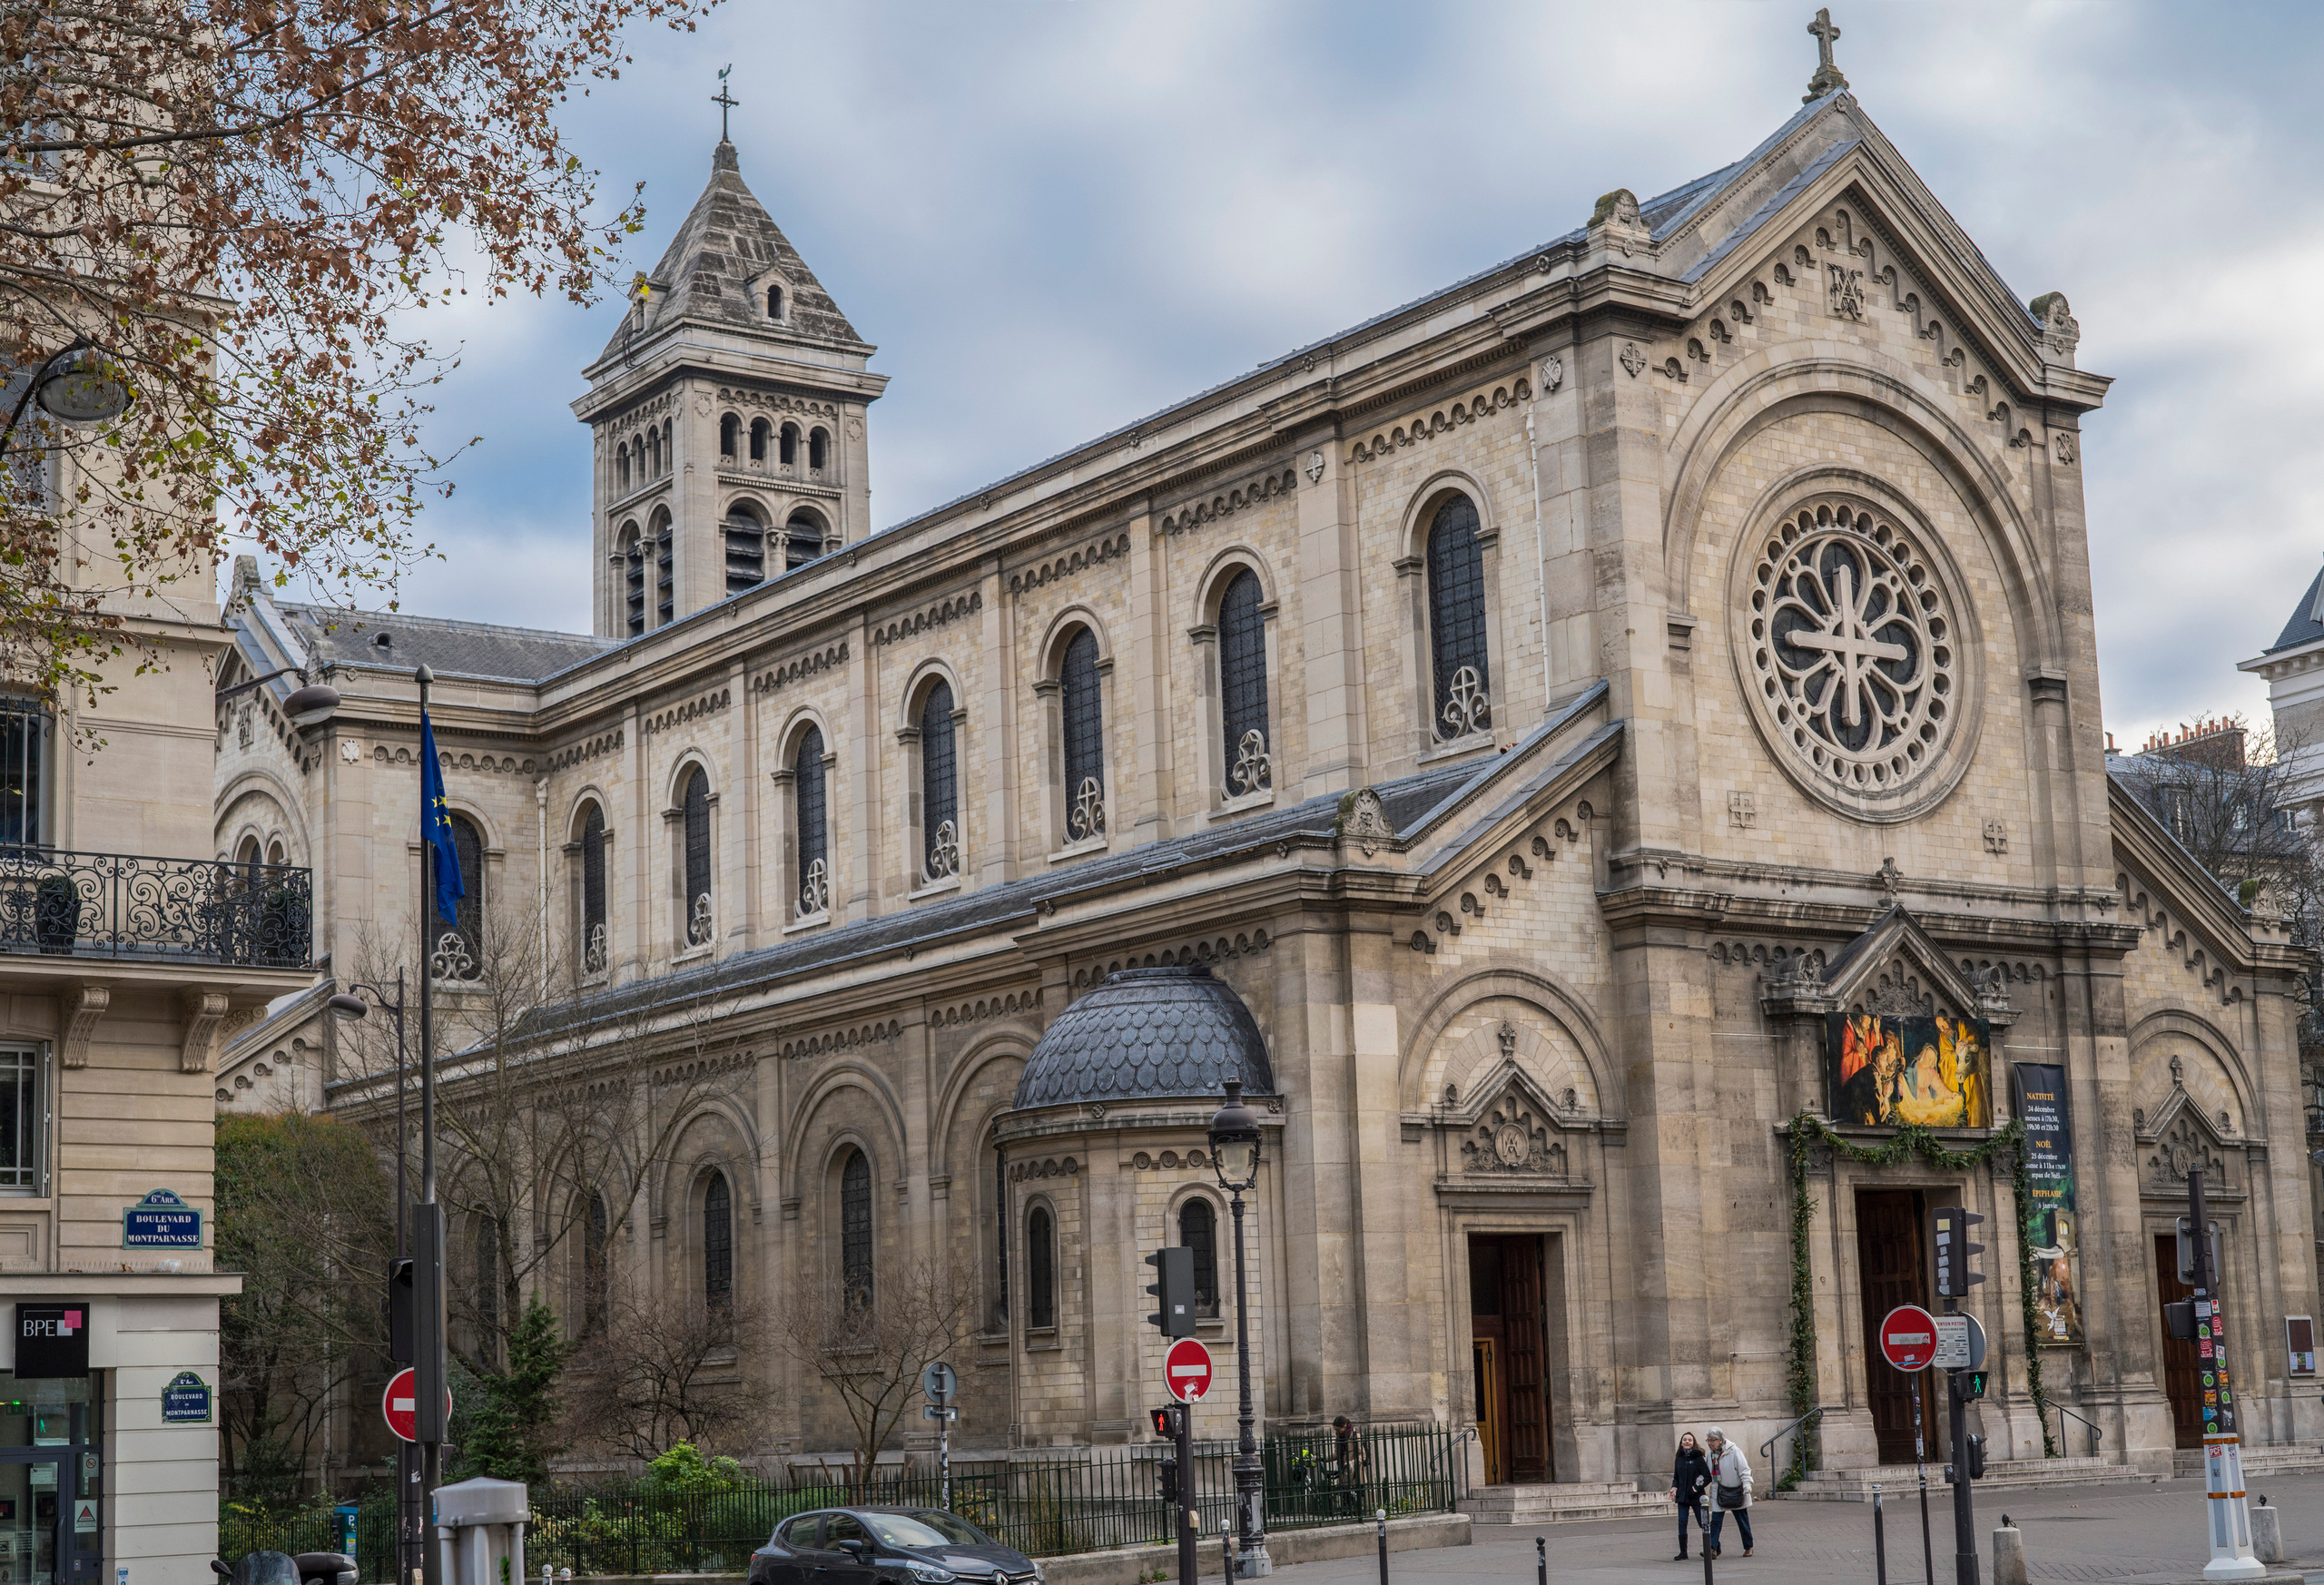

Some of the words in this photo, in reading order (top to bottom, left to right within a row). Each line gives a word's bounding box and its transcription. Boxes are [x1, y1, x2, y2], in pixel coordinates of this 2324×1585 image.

[2026, 1092, 2055, 1101] NATIVITÉ
[2034, 1105, 2055, 1113] décembre
[2035, 1139, 2052, 1148] NOËL
[136, 1215, 192, 1223] BOULEVARD
[157, 1225, 170, 1233] DU
[127, 1235, 199, 1243] MONTPARNASSE
[23, 1319, 55, 1337] BPE
